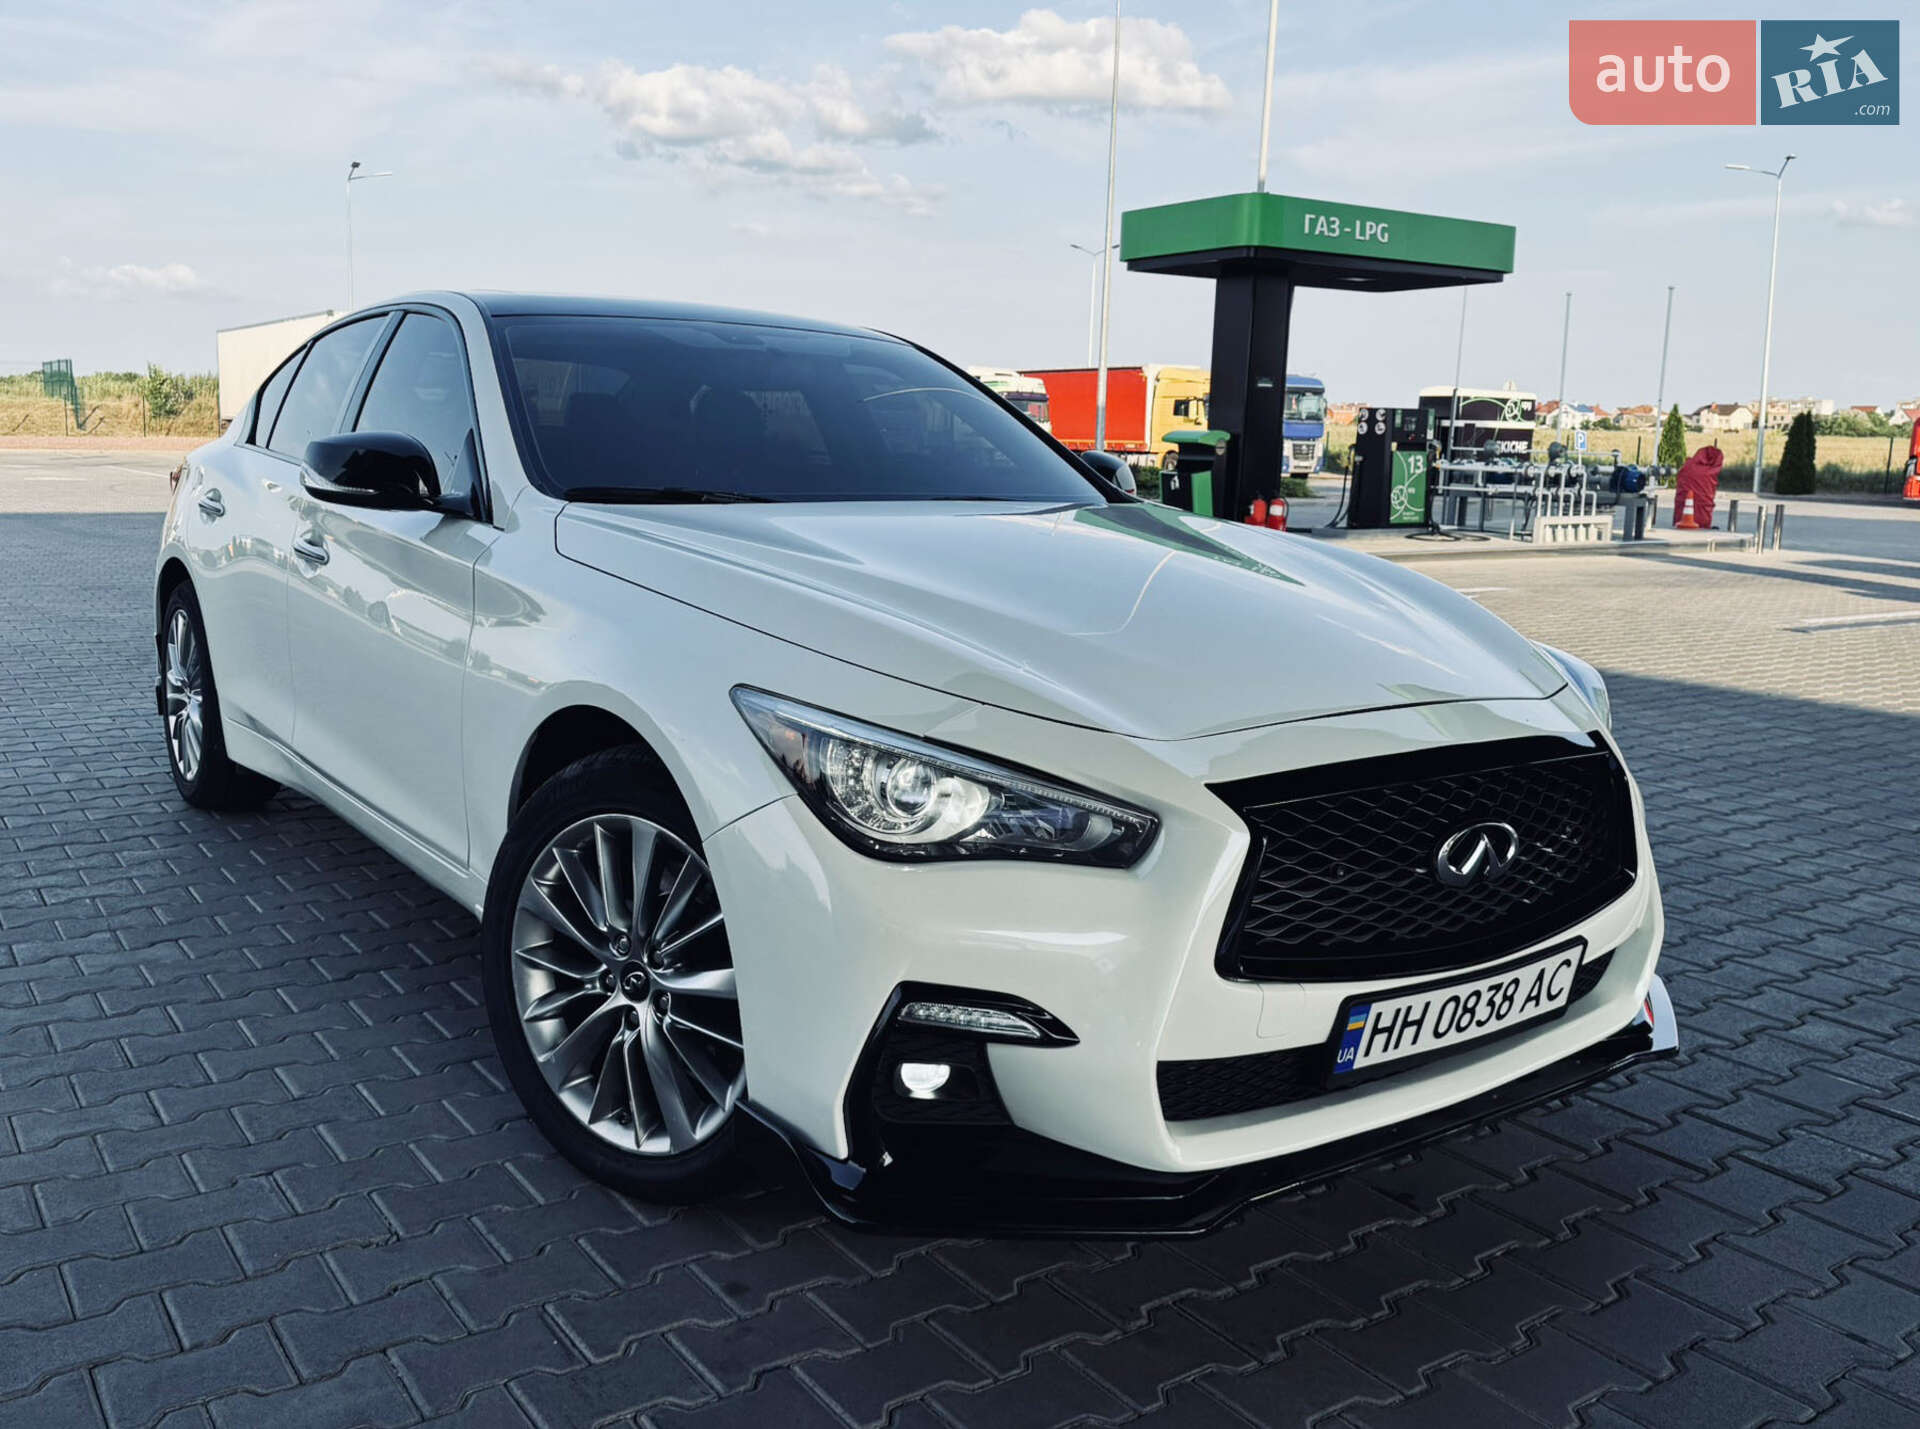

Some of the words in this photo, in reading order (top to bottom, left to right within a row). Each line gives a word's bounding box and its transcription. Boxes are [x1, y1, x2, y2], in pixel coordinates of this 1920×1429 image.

[1304, 213, 1340, 238] ГАЗ
[1355, 219, 1389, 243] LPG
[1407, 455, 1424, 474] 13
[1363, 1001, 1431, 1057] HH
[1433, 977, 1520, 1039] 0838
[1519, 958, 1572, 1014] AC
[1337, 1047, 1355, 1063] UA
